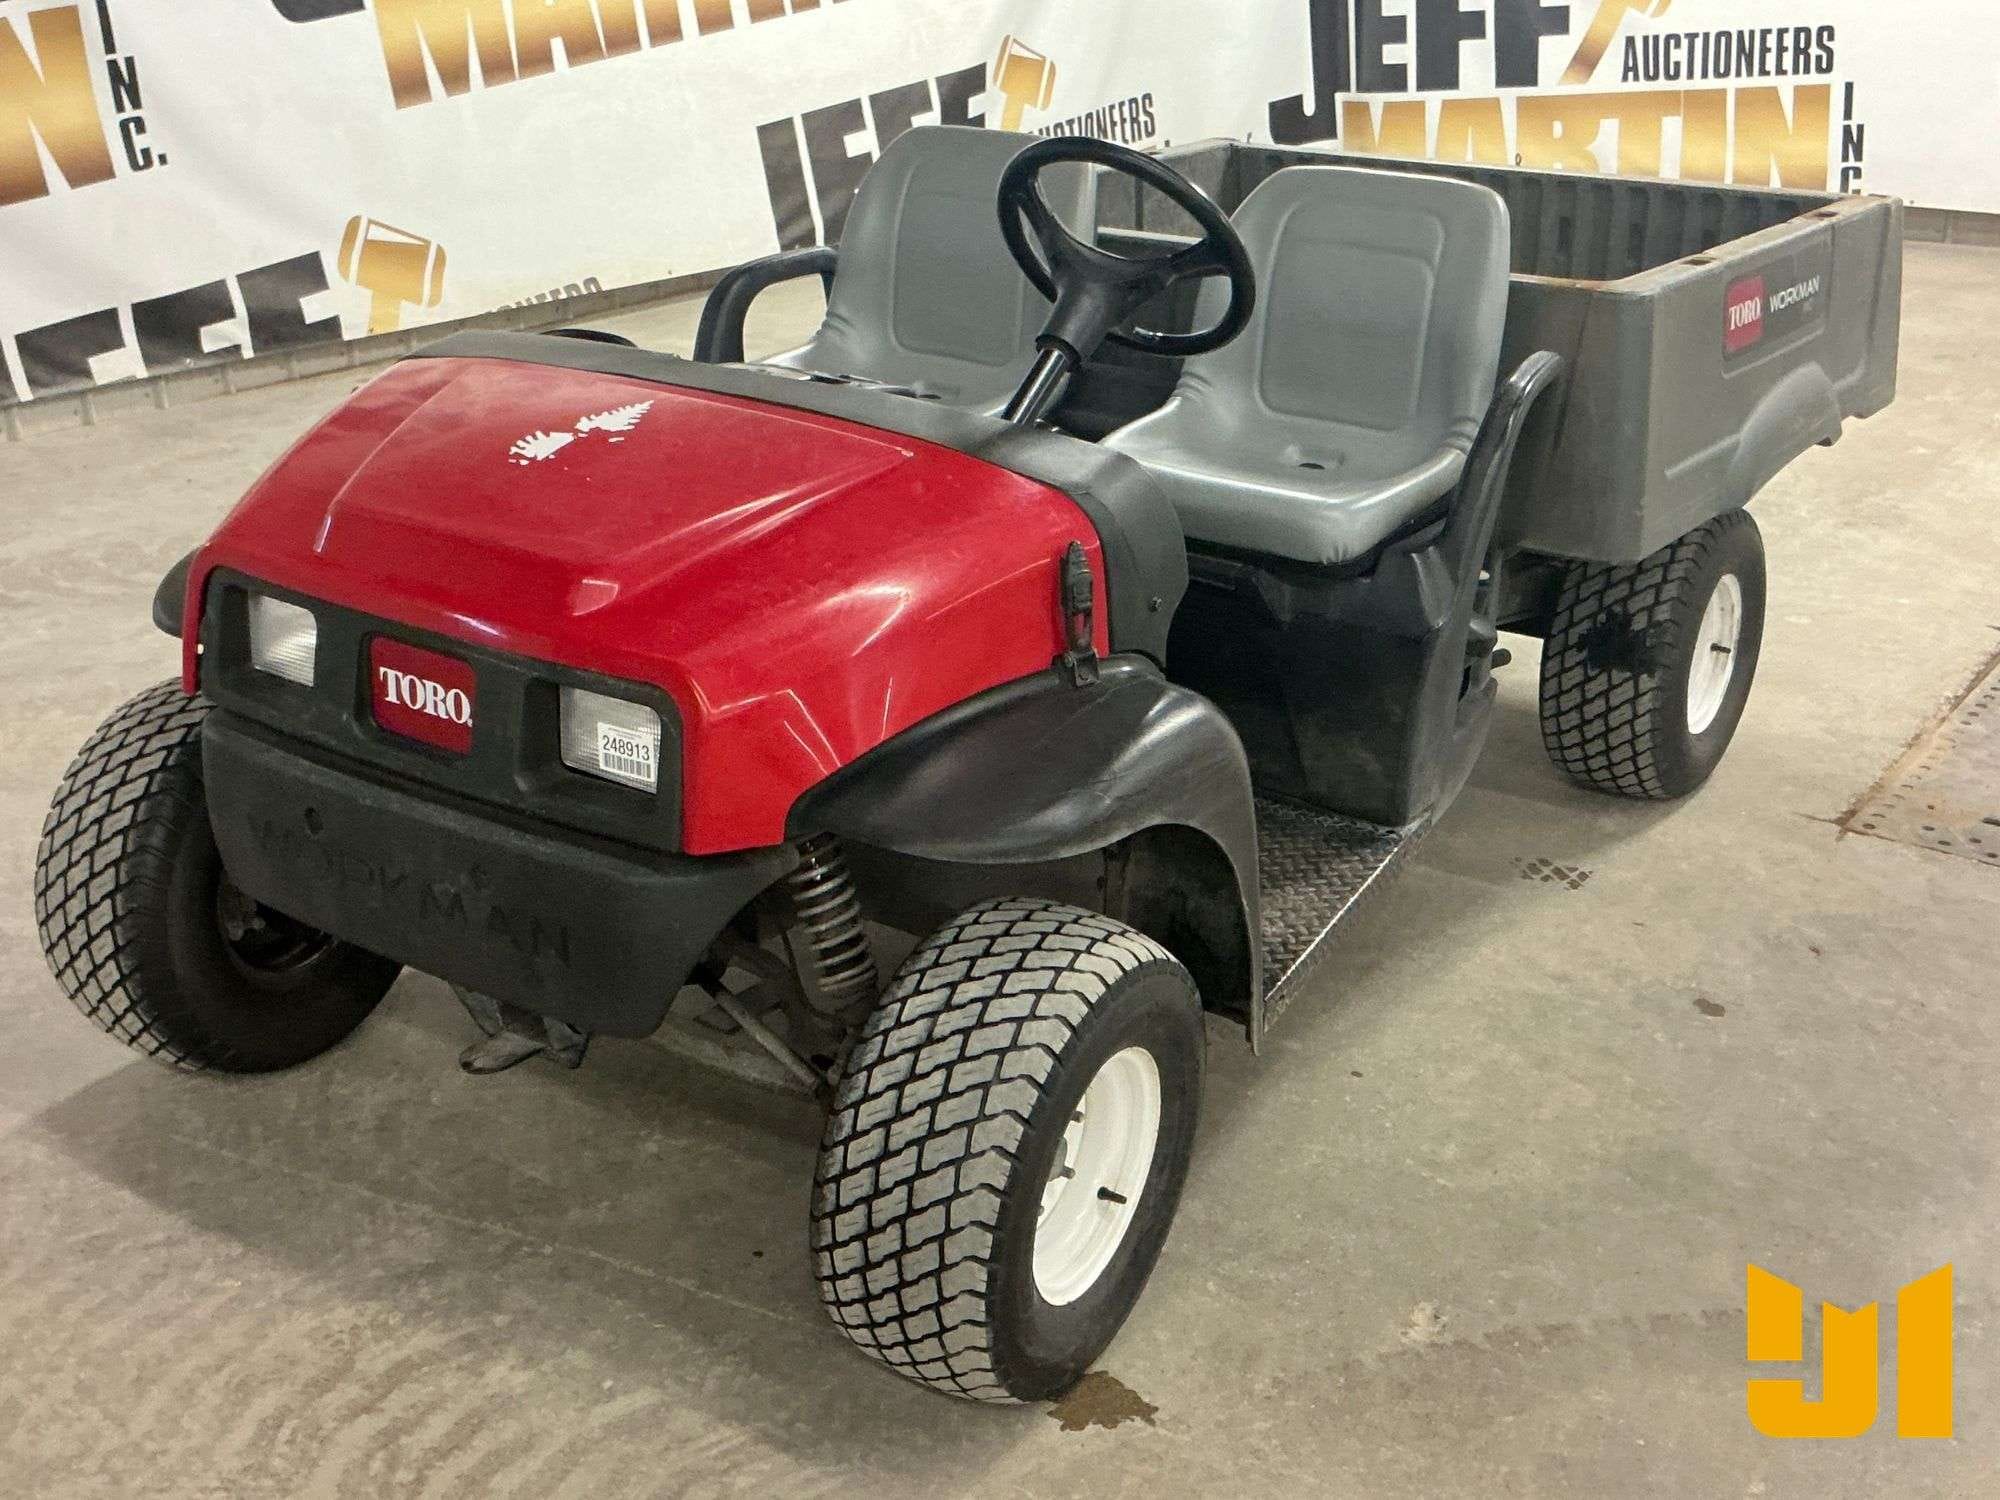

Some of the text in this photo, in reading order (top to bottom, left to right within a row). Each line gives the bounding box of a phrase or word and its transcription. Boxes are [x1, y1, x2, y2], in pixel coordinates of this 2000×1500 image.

[1621, 25, 1836, 83] AUCTIONEERS
[1728, 275, 1820, 331] TORO WORKMAN
[379, 665, 472, 728] TORO
[602, 734, 650, 761] 248913
